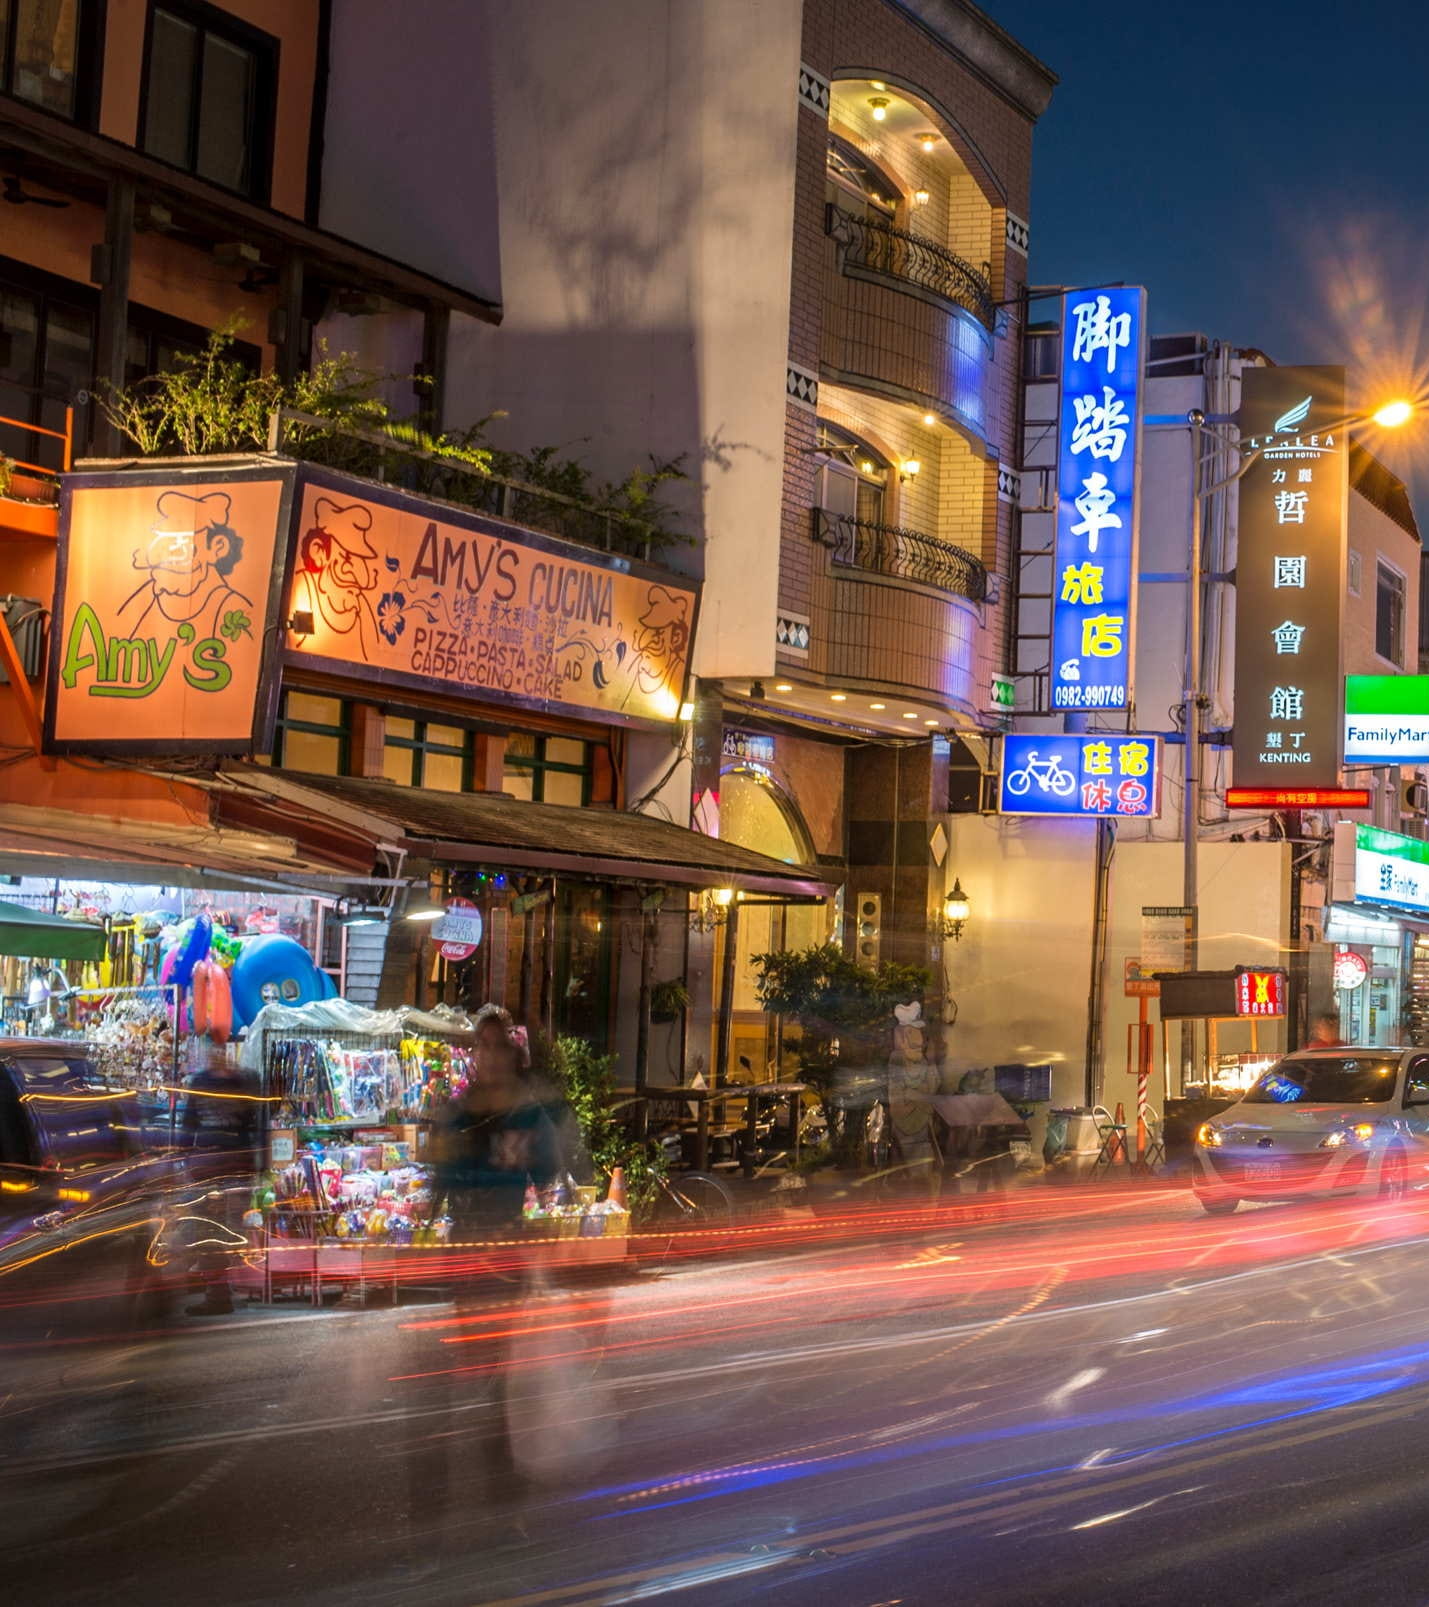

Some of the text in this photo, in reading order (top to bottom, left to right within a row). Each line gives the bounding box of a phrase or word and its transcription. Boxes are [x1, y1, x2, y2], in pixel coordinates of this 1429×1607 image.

[1250, 435, 1335, 449] LELEA
[1264, 451, 1321, 460] GARDEN HOTELS
[1271, 468, 1313, 483] 力麗
[410, 522, 614, 628] AMY'S CUCINA
[1269, 490, 1309, 721] 哲園會館
[62, 602, 232, 699] Amy's
[414, 627, 582, 682] PIZZA PASTA SALAD
[410, 650, 562, 699] CAPPUCCINO CAKE
[1055, 685, 1125, 707] 0982-990749
[1259, 753, 1312, 763] KENTING
[1265, 732, 1306, 749] 墾丁
[1082, 741, 1149, 776] 住宿
[1081, 778, 1148, 813] 休息
